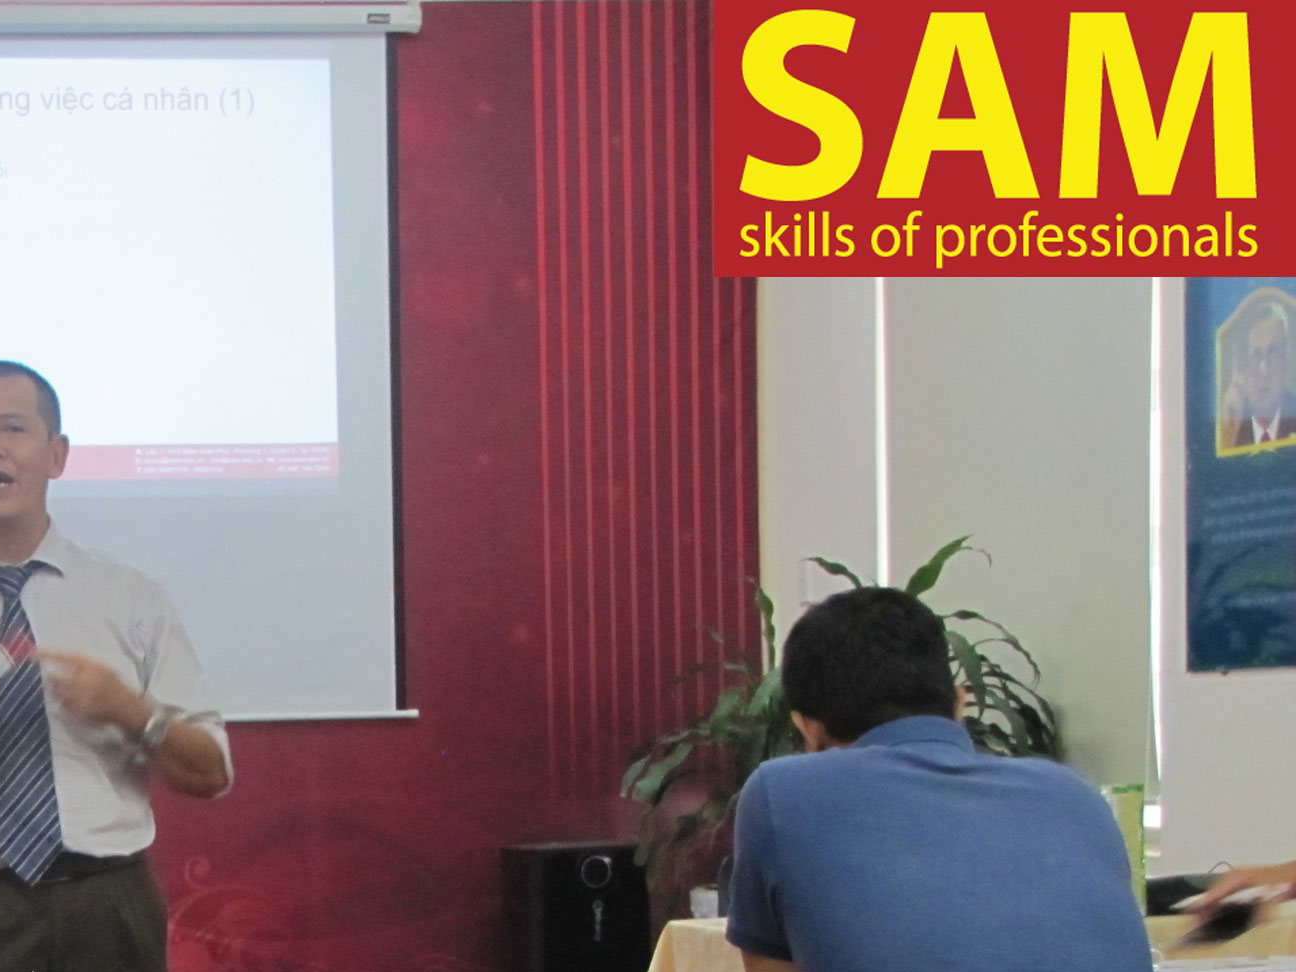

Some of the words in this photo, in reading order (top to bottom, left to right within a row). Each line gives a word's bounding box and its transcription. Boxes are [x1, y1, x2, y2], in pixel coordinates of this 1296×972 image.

[40, 86, 95, 117] việc
[103, 85, 134, 111] cá
[144, 86, 209, 112] nhân
[219, 87, 255, 117] (1)
